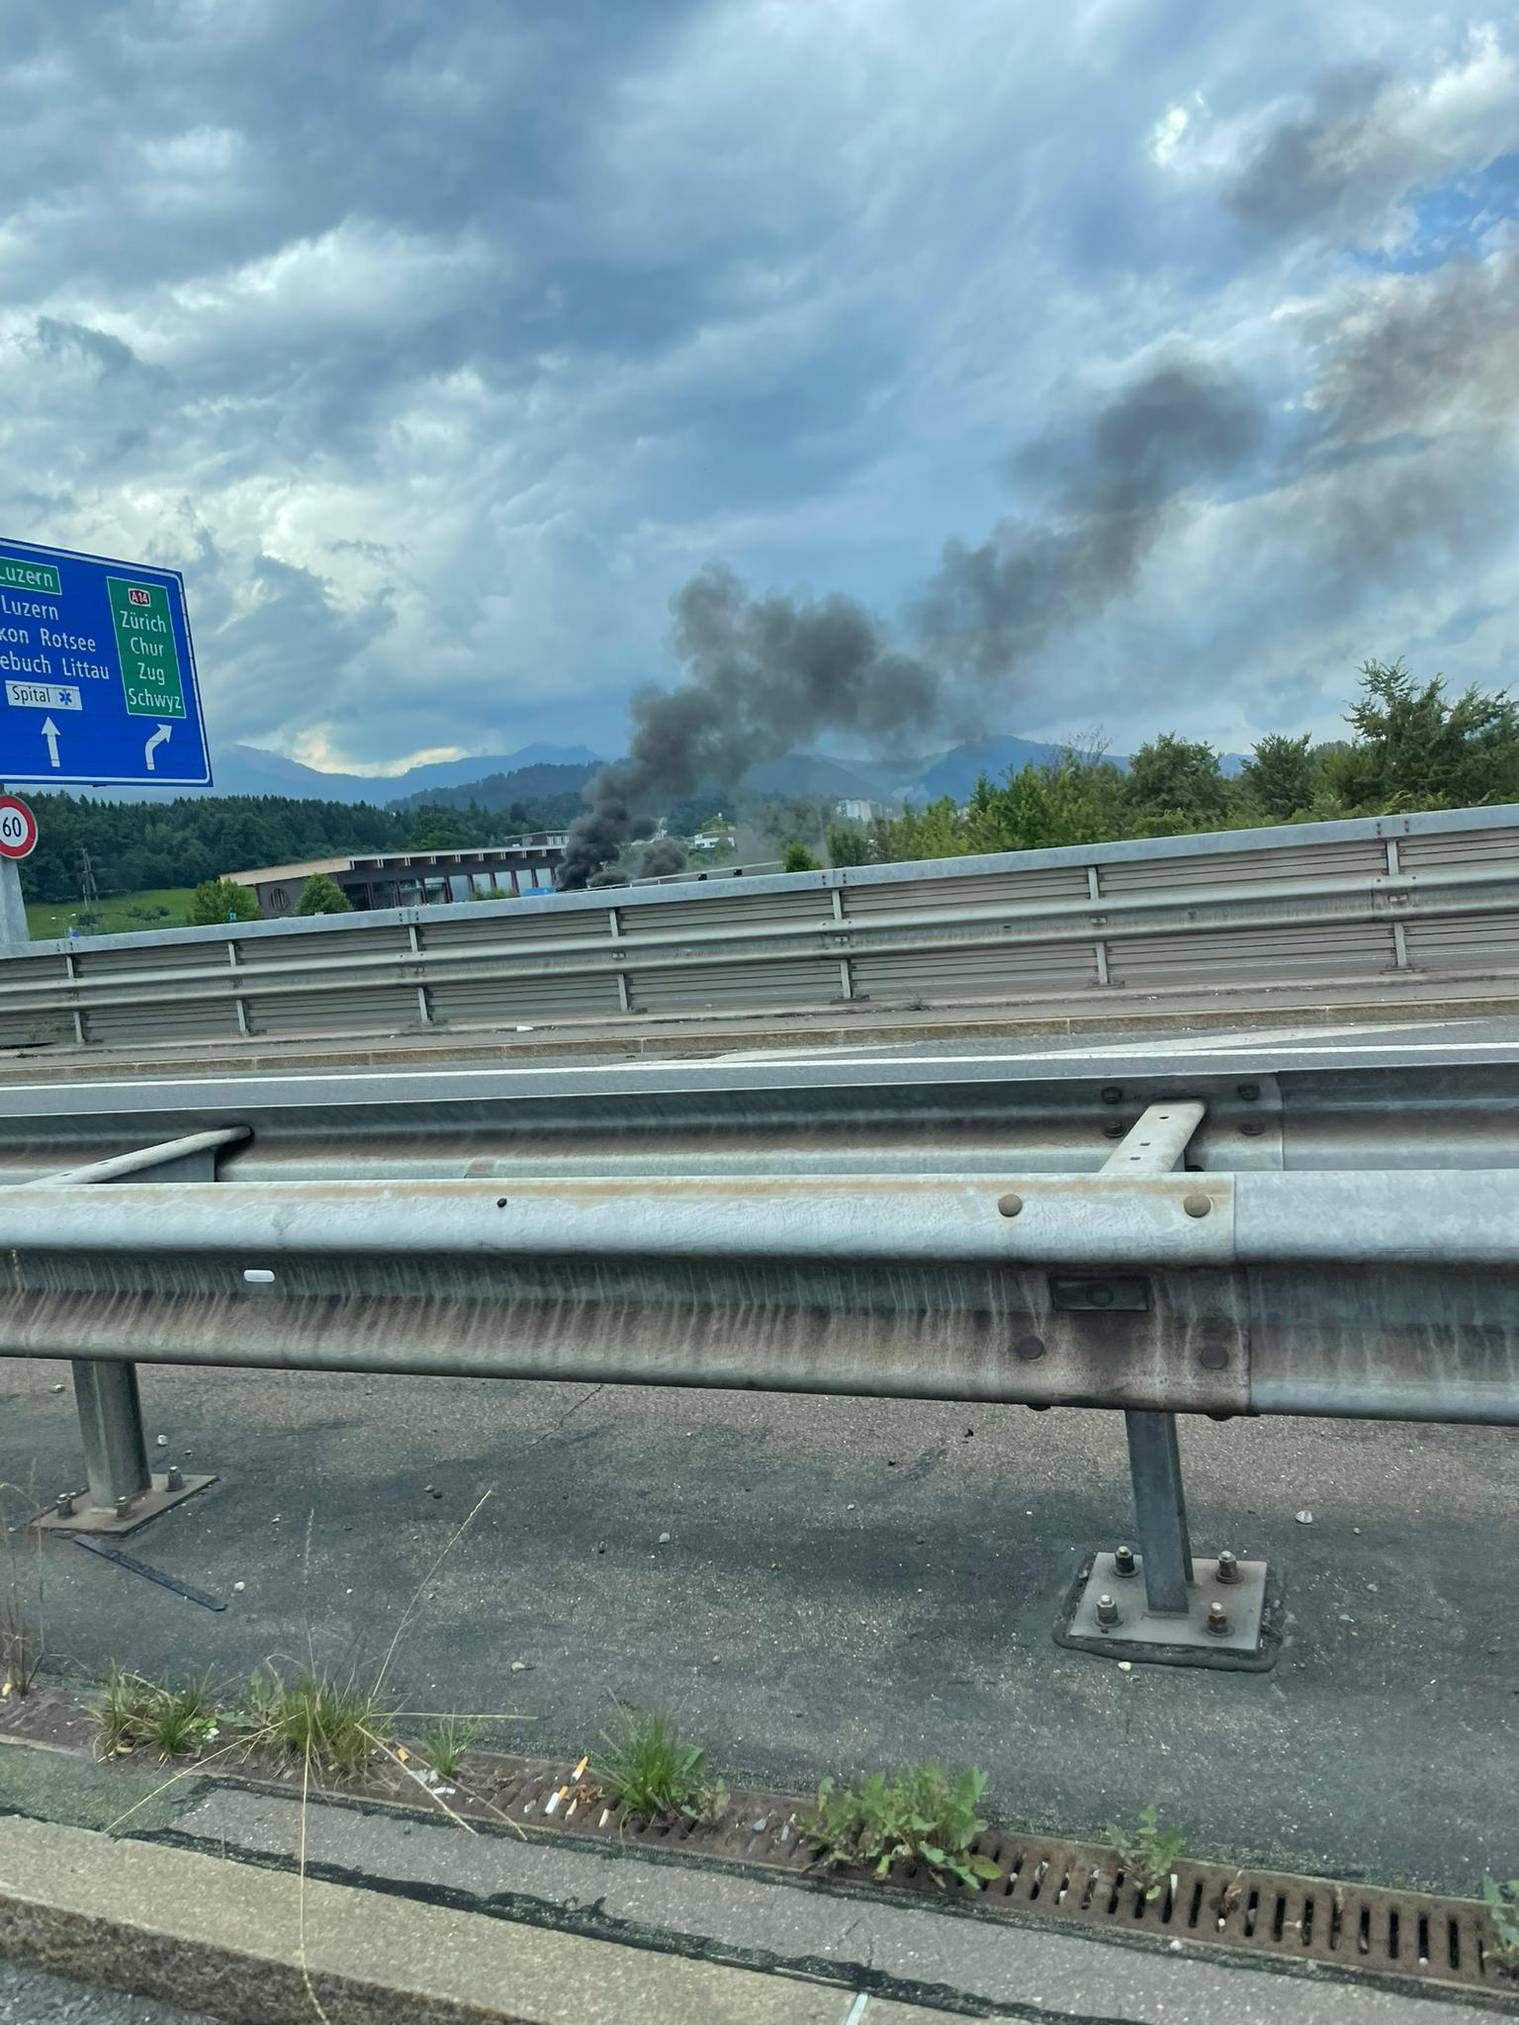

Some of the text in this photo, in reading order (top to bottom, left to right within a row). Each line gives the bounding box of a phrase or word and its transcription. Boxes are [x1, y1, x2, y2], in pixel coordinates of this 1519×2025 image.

[0, 567, 53, 587] uzern
[1, 595, 59, 620] Luzern
[131, 591, 148, 604] A14
[120, 610, 166, 633] Zürich
[40, 628, 96, 652] Rotsee
[130, 637, 163, 656] Chur
[62, 658, 110, 680] Littau
[137, 662, 165, 685] Zug
[12, 686, 50, 704] Spital
[128, 688, 182, 712] Schwyz
[3, 816, 21, 837] 60
